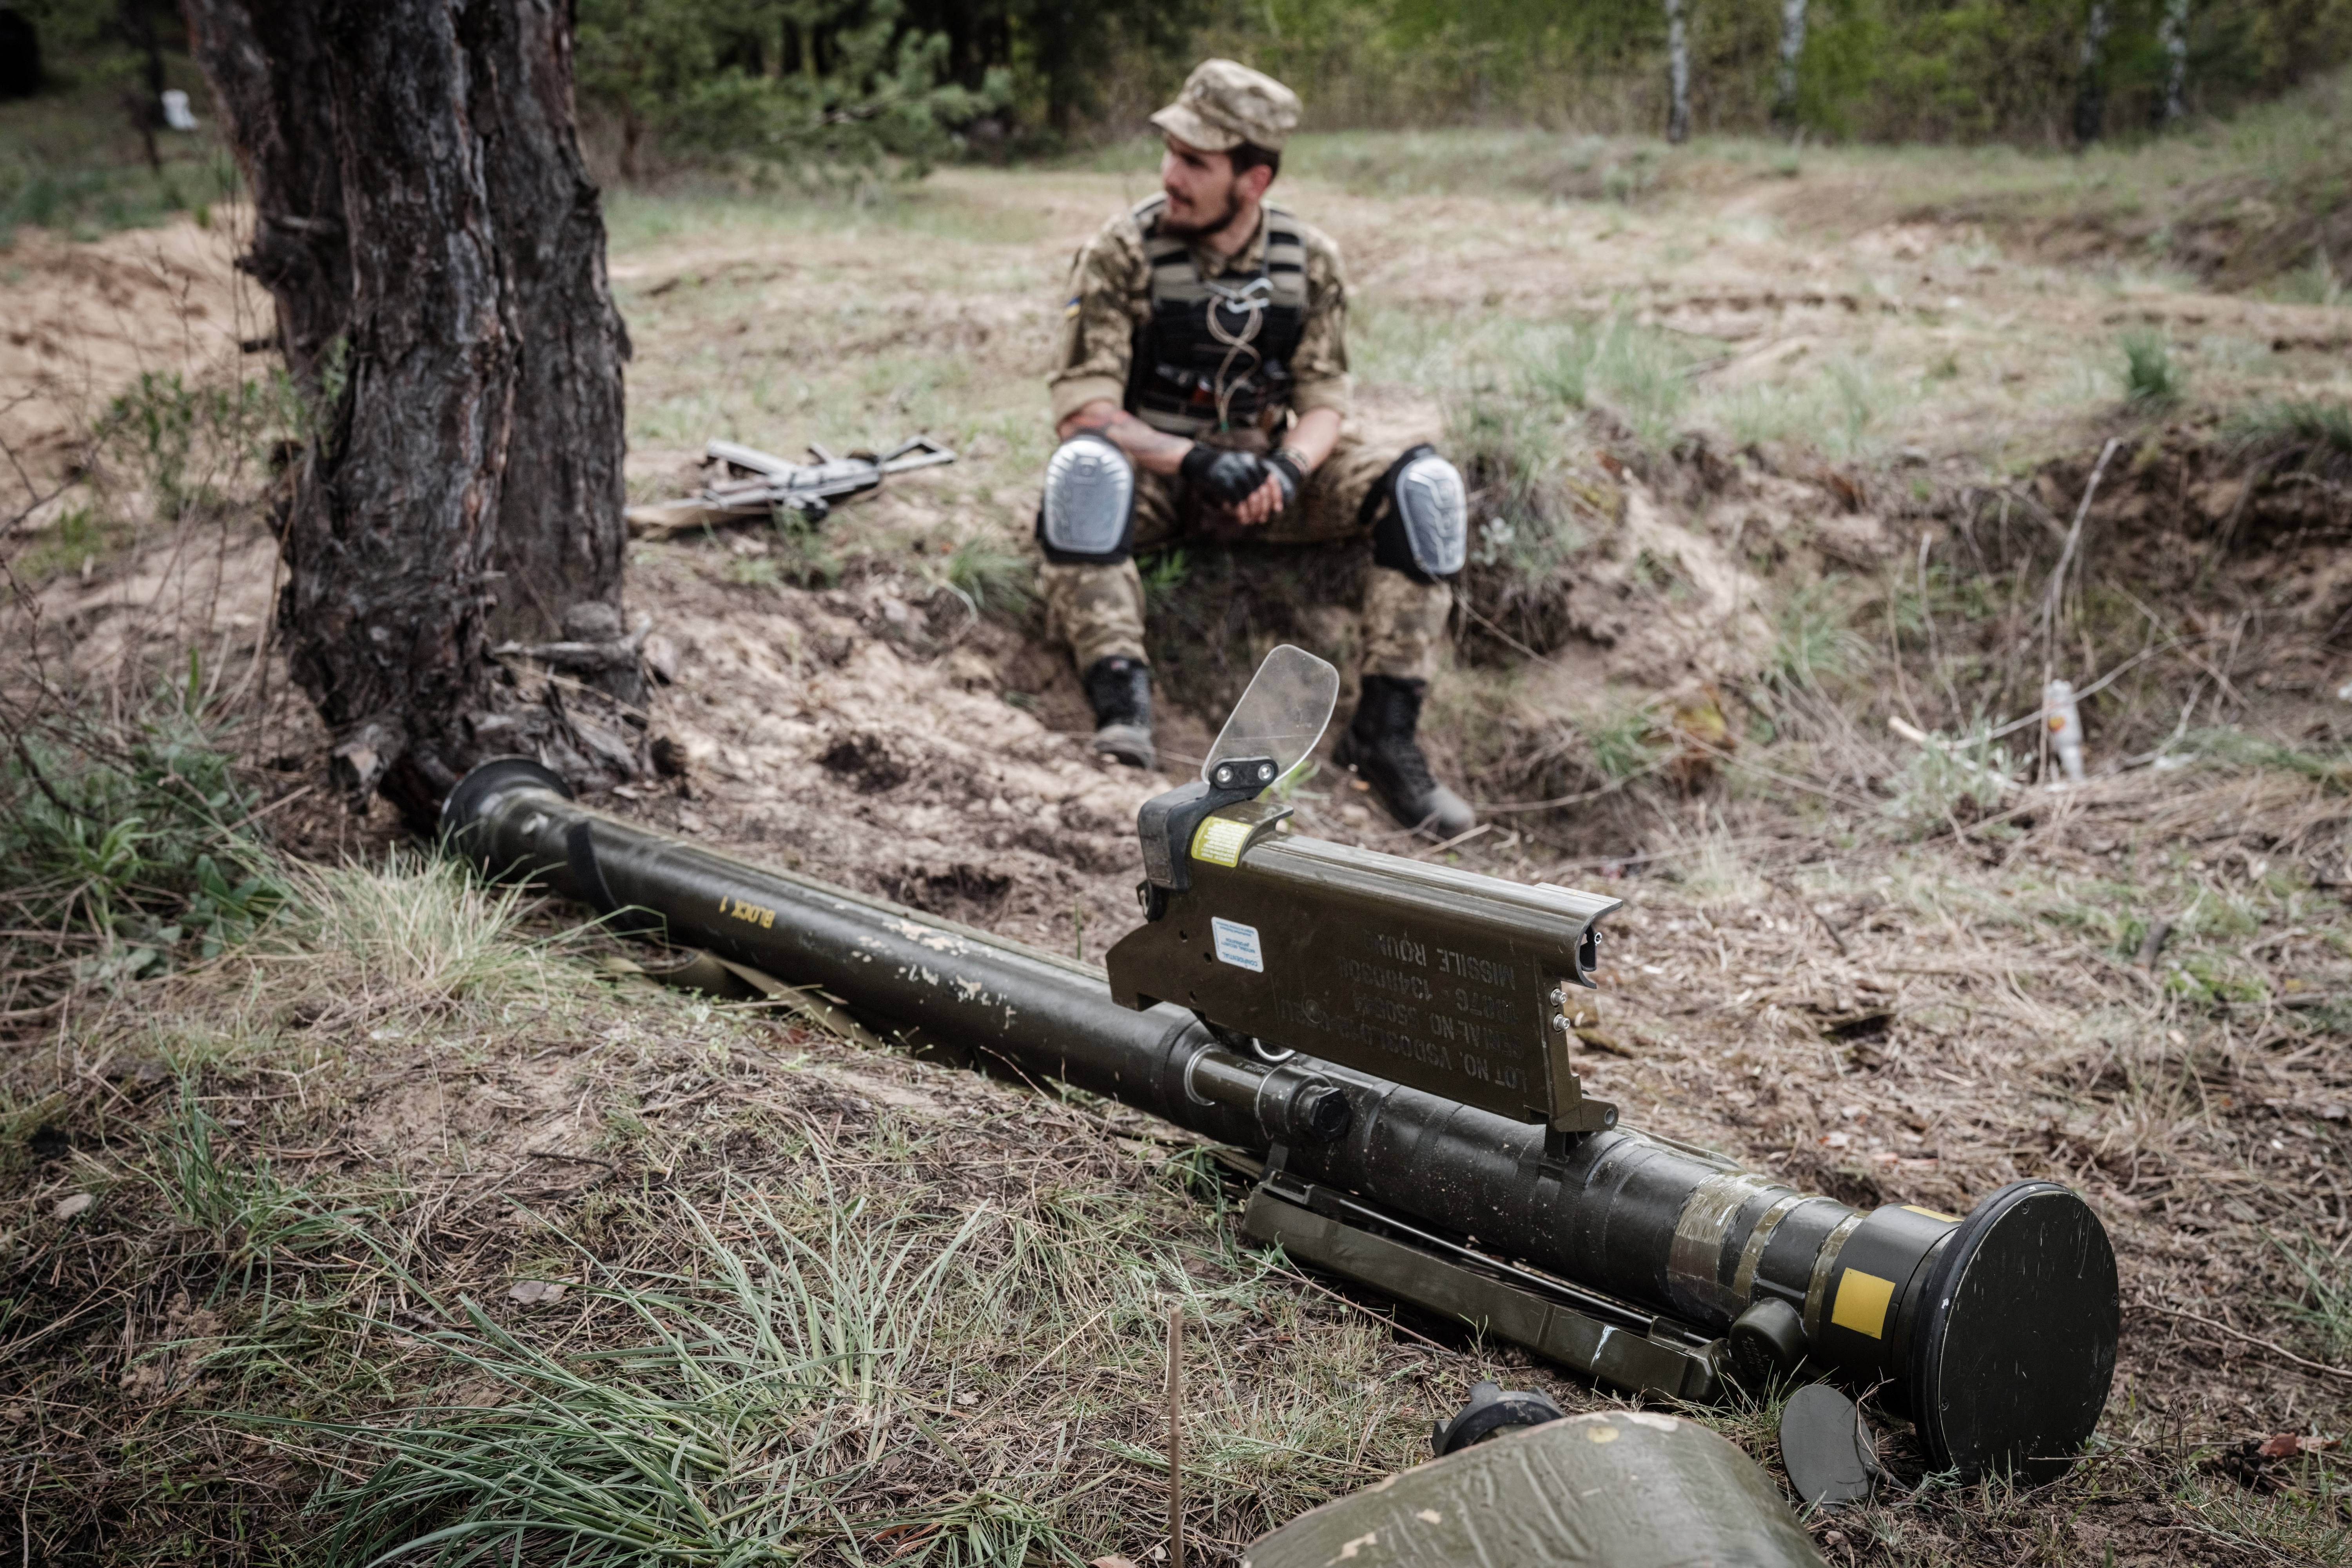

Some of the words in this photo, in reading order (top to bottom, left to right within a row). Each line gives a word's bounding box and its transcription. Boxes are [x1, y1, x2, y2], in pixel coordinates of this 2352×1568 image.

[731, 899, 776, 929] BLOCK
[1437, 948, 1515, 990] MISSILE
[1458, 1020, 1524, 1059] SERIAL
[1460, 1051, 1488, 1080] NO.
[1495, 1062, 1526, 1093] LOT
